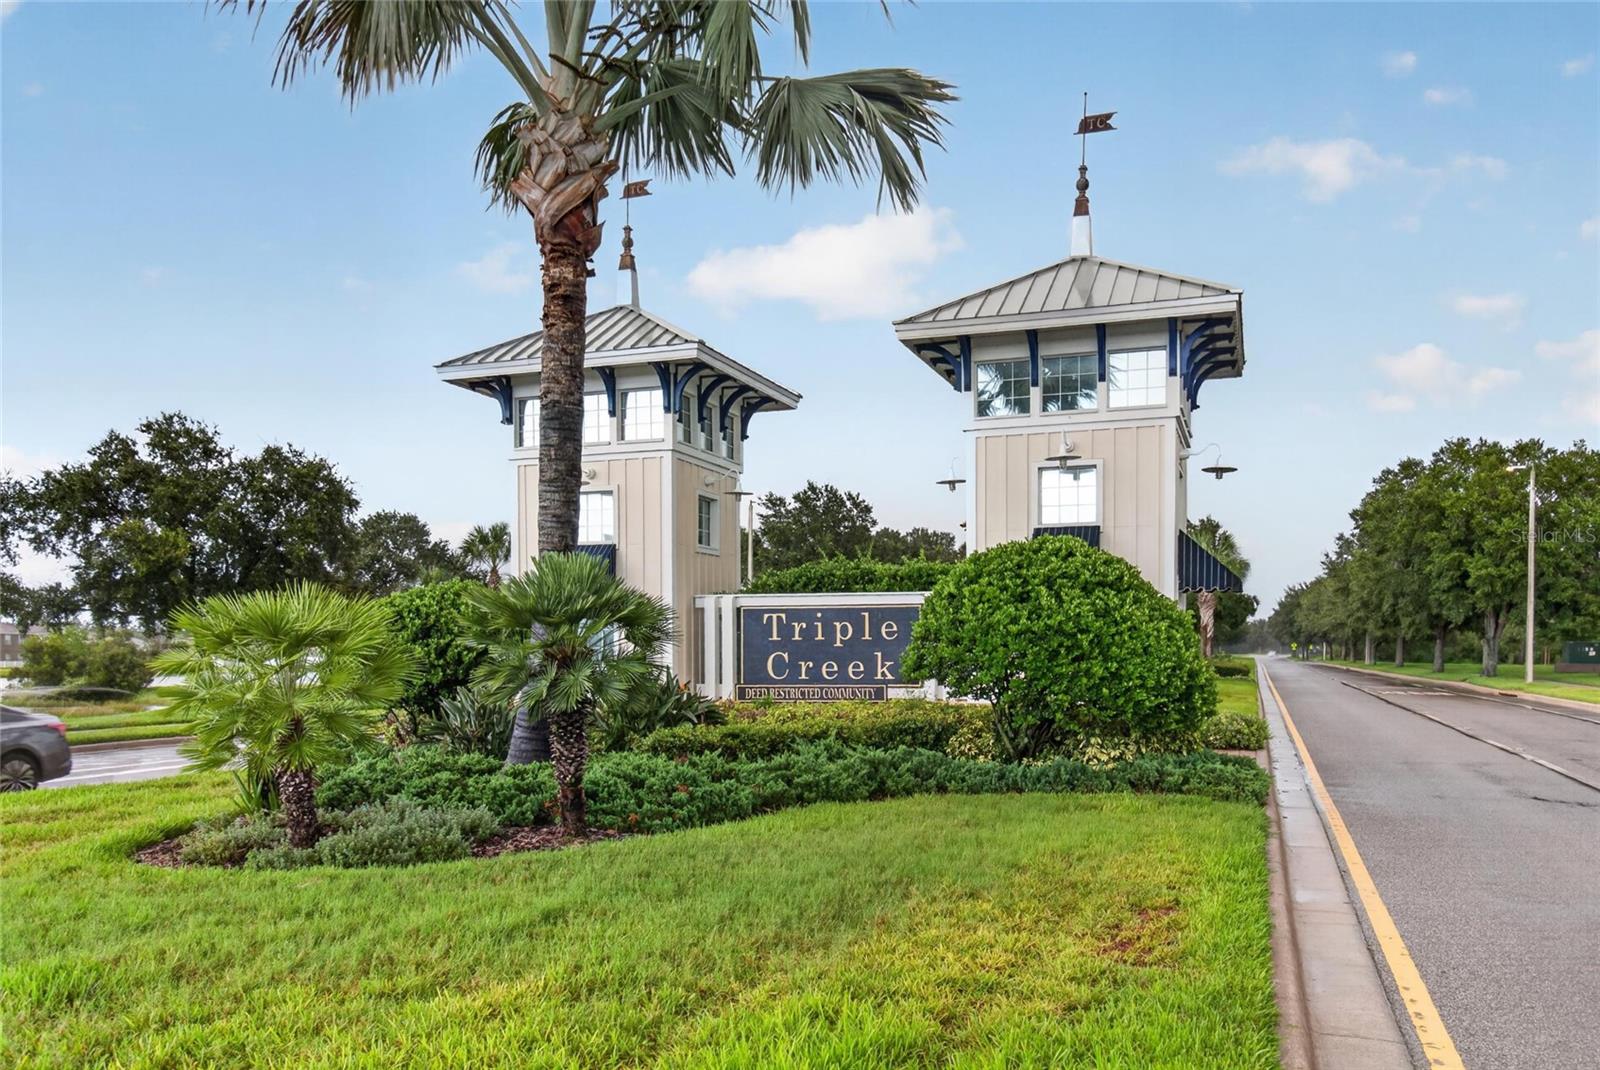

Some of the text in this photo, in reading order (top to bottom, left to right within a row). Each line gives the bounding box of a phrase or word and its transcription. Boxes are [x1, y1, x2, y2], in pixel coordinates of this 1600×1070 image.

[763, 612, 899, 647] Triple
[766, 651, 895, 680] Creek
[770, 687, 820, 699] RESTRICTED
[822, 687, 877, 699] COMMUNITY
